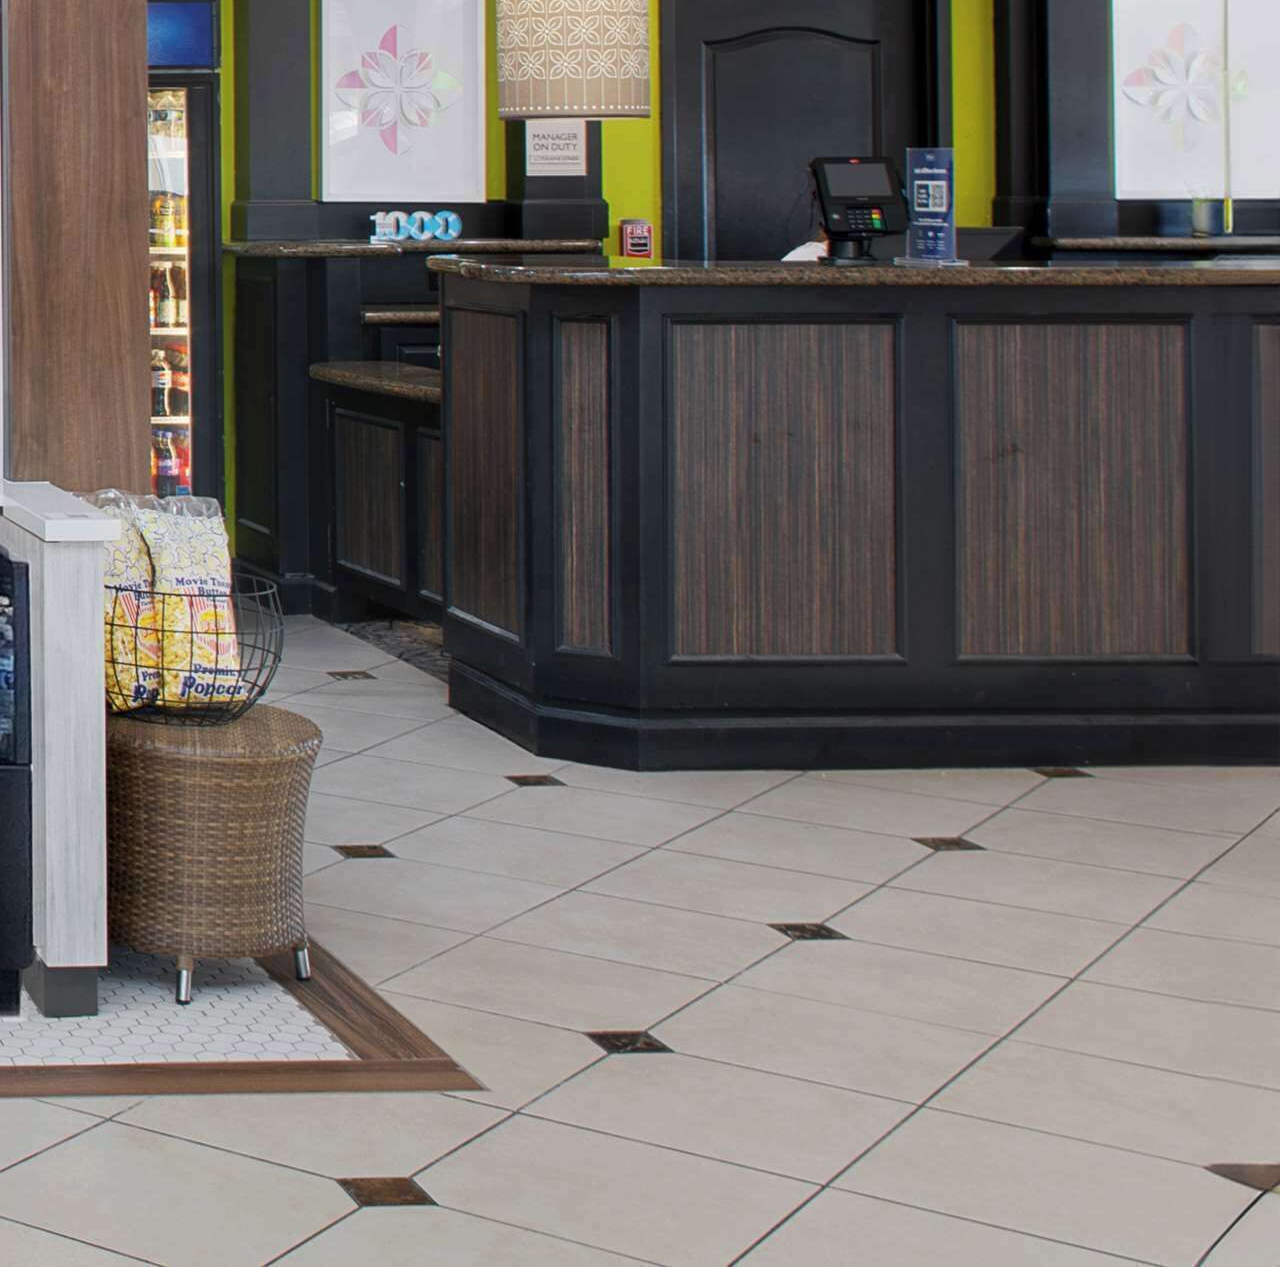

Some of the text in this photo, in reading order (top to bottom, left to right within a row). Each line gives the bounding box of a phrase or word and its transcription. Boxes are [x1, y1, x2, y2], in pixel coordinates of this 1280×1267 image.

[532, 133, 577, 141] MANAGER
[533, 143, 577, 151] ON DUTY
[627, 227, 649, 235] FIRE
[175, 577, 208, 587] Movie
